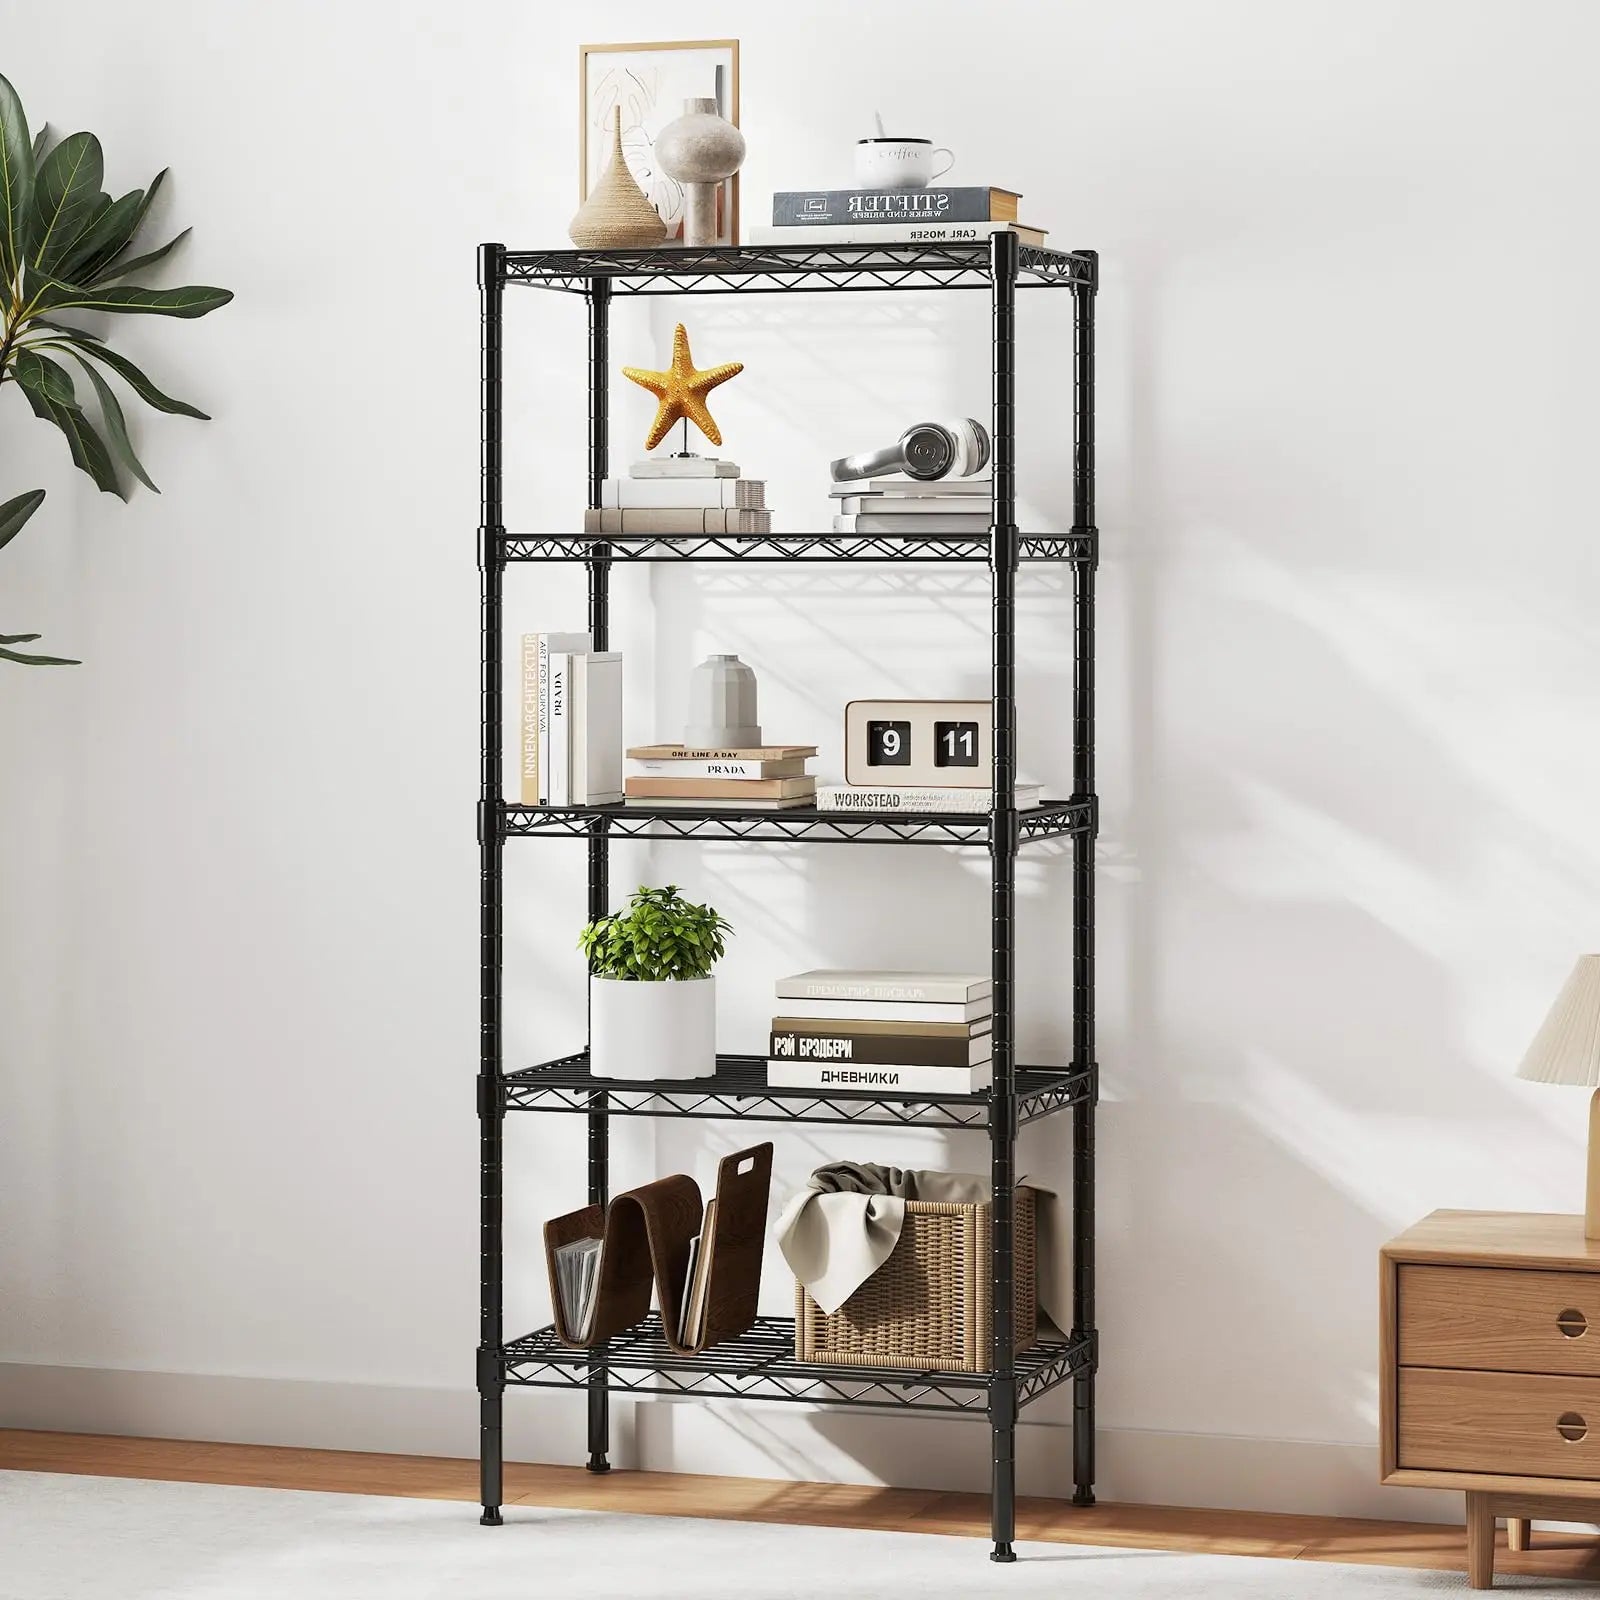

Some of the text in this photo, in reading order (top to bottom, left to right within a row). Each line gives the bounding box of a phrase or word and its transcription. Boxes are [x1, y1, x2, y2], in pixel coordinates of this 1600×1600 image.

[539, 641, 547, 734] ART FOR SURVIVAL
[554, 672, 562, 716] PRADA
[524, 634, 537, 778] INNENARCHITEKTUR
[882, 729, 901, 757] 9
[942, 730, 973, 757] 11
[707, 765, 746, 775] PRADA
[834, 792, 901, 808] WORKSTEAD
[774, 1034, 852, 1059] РЭЙ БРЭДБЕРИ
[821, 1070, 899, 1085] ДНЕВНИКИ
